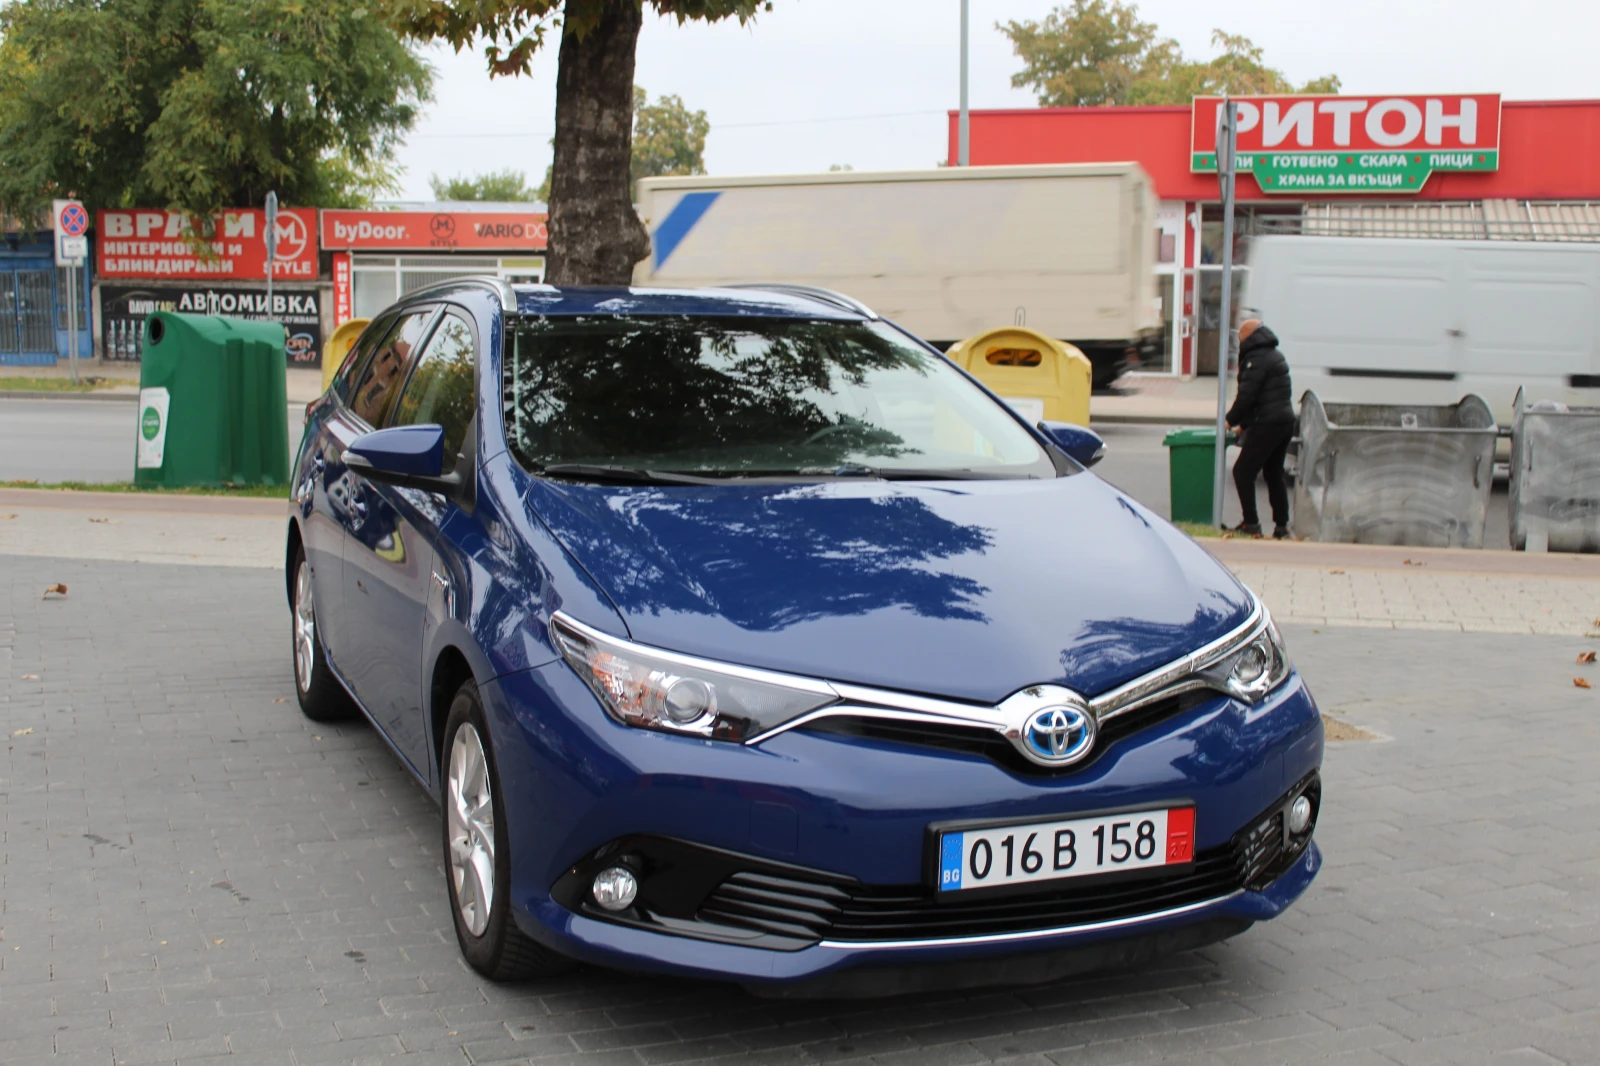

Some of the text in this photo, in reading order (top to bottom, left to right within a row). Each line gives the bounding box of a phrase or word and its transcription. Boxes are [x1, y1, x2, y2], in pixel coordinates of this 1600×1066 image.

[1216, 98, 1478, 147] РИТОН
[1272, 155, 1339, 168] ГОТВЕНО
[1359, 154, 1408, 168] СКАРА
[1429, 154, 1474, 169] ПИЦИ
[1278, 173, 1403, 188] ХРАНА ЗА ВКЪЩИ
[105, 259, 233, 274] БЛИНДИРАНИ
[969, 819, 1156, 880] 016 B 158
[943, 868, 960, 884] BG
